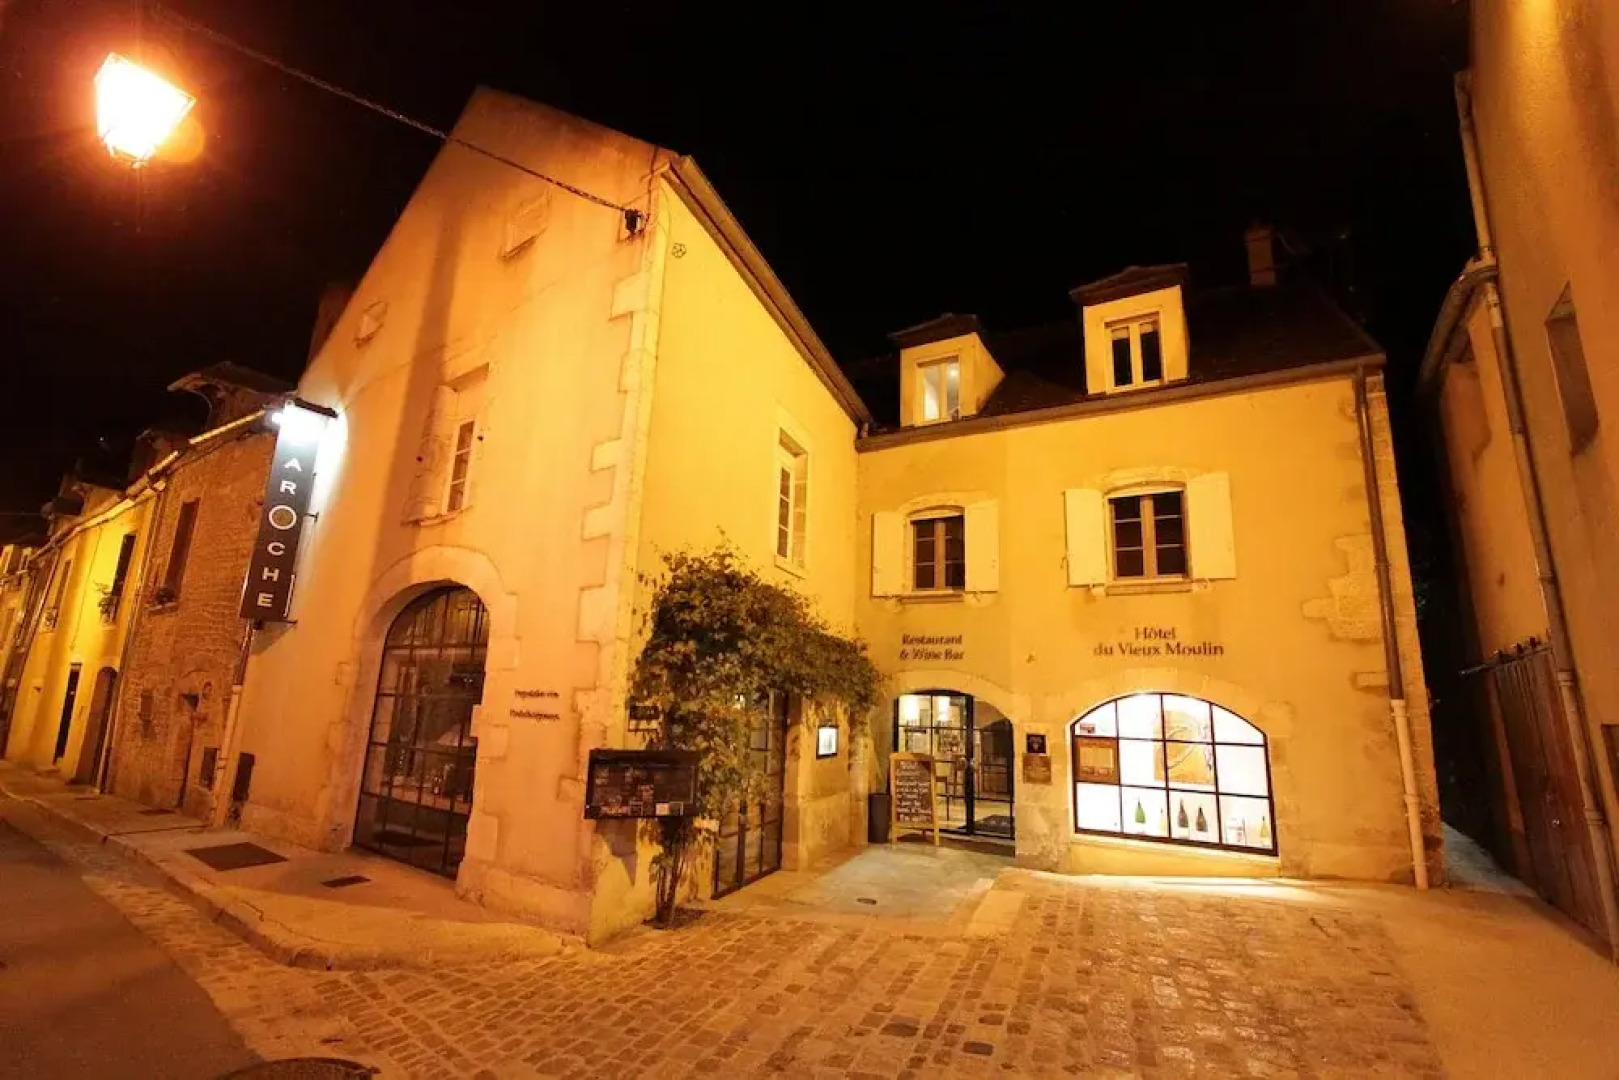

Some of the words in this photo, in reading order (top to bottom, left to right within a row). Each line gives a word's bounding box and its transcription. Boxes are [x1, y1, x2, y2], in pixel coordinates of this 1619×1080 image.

[1134, 626, 1177, 640] Hôtel
[944, 648, 965, 660] Bar
[1094, 643, 1114, 656] du
[1118, 643, 1161, 655] Vieux
[1165, 641, 1224, 656] Moulin
